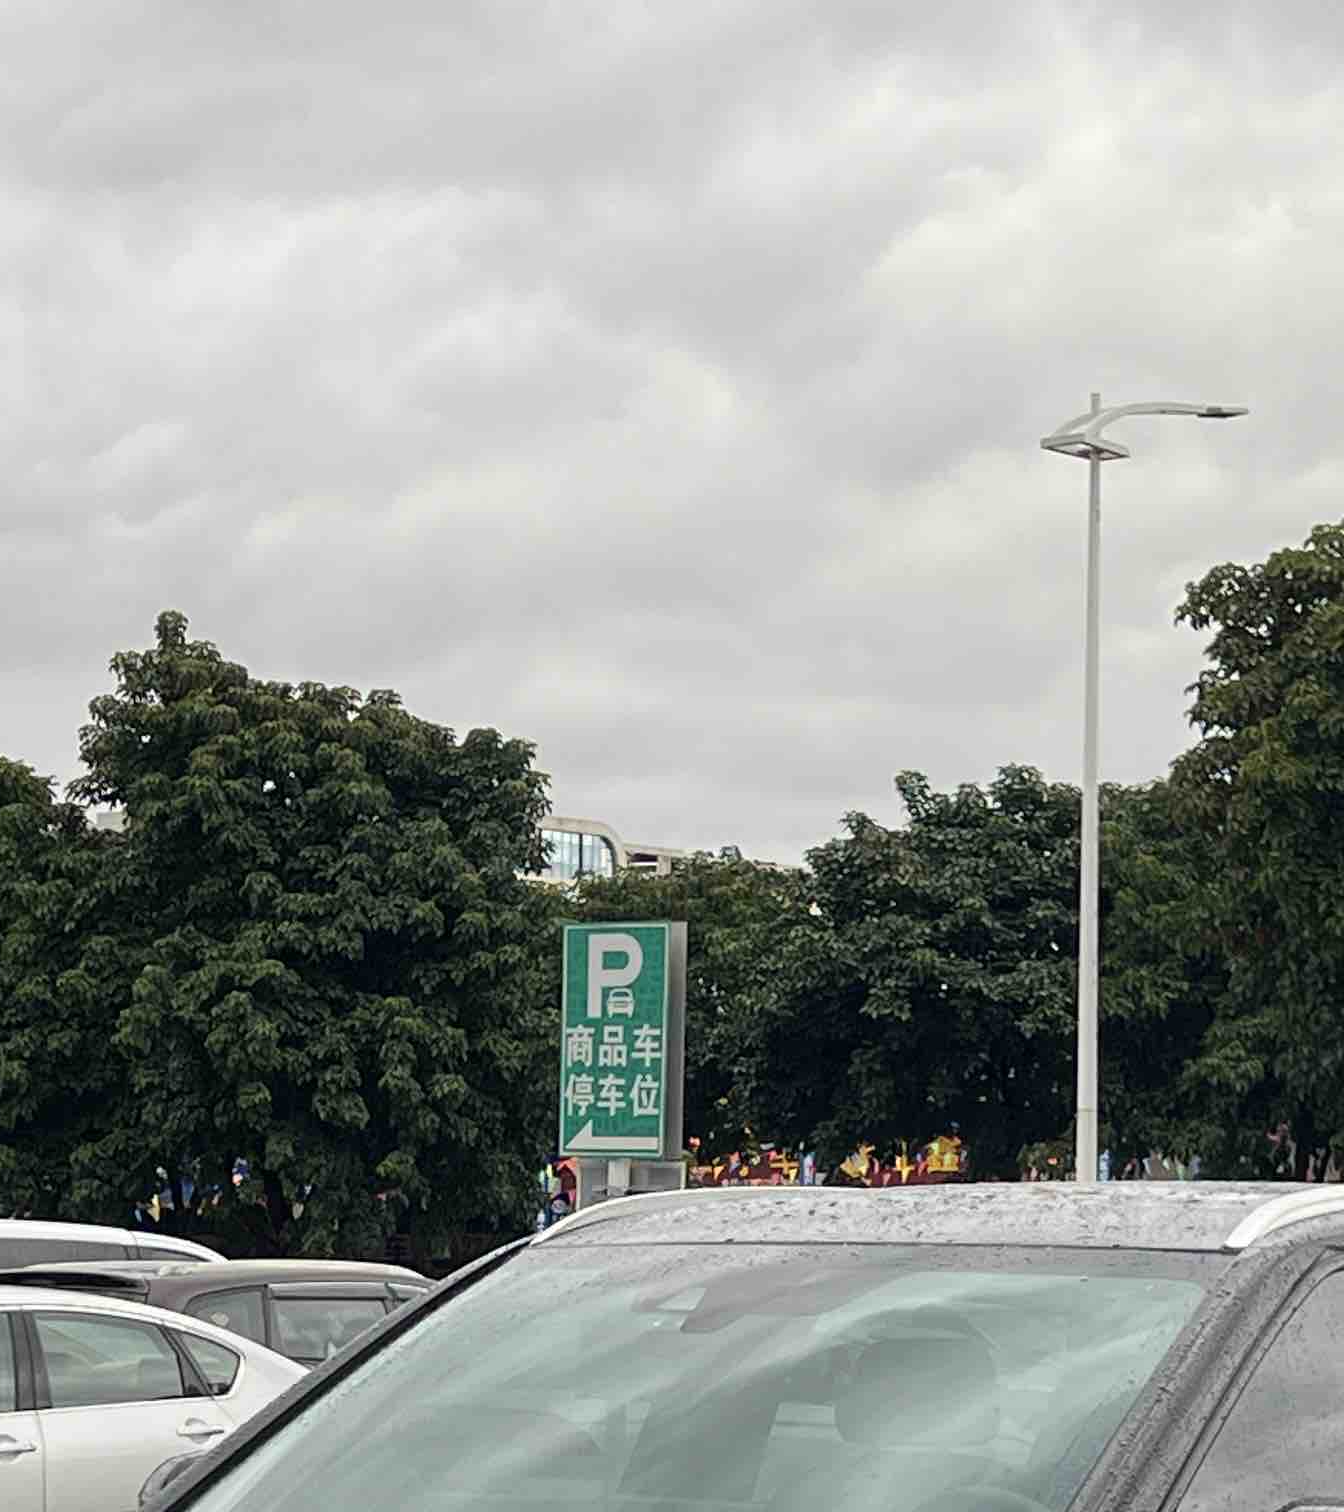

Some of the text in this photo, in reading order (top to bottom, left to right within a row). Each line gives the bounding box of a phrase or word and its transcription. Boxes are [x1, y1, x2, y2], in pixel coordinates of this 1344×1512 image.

[587, 932, 644, 1019] P
[565, 1023, 662, 1068] 商品车
[564, 1073, 660, 1118] 停车位
